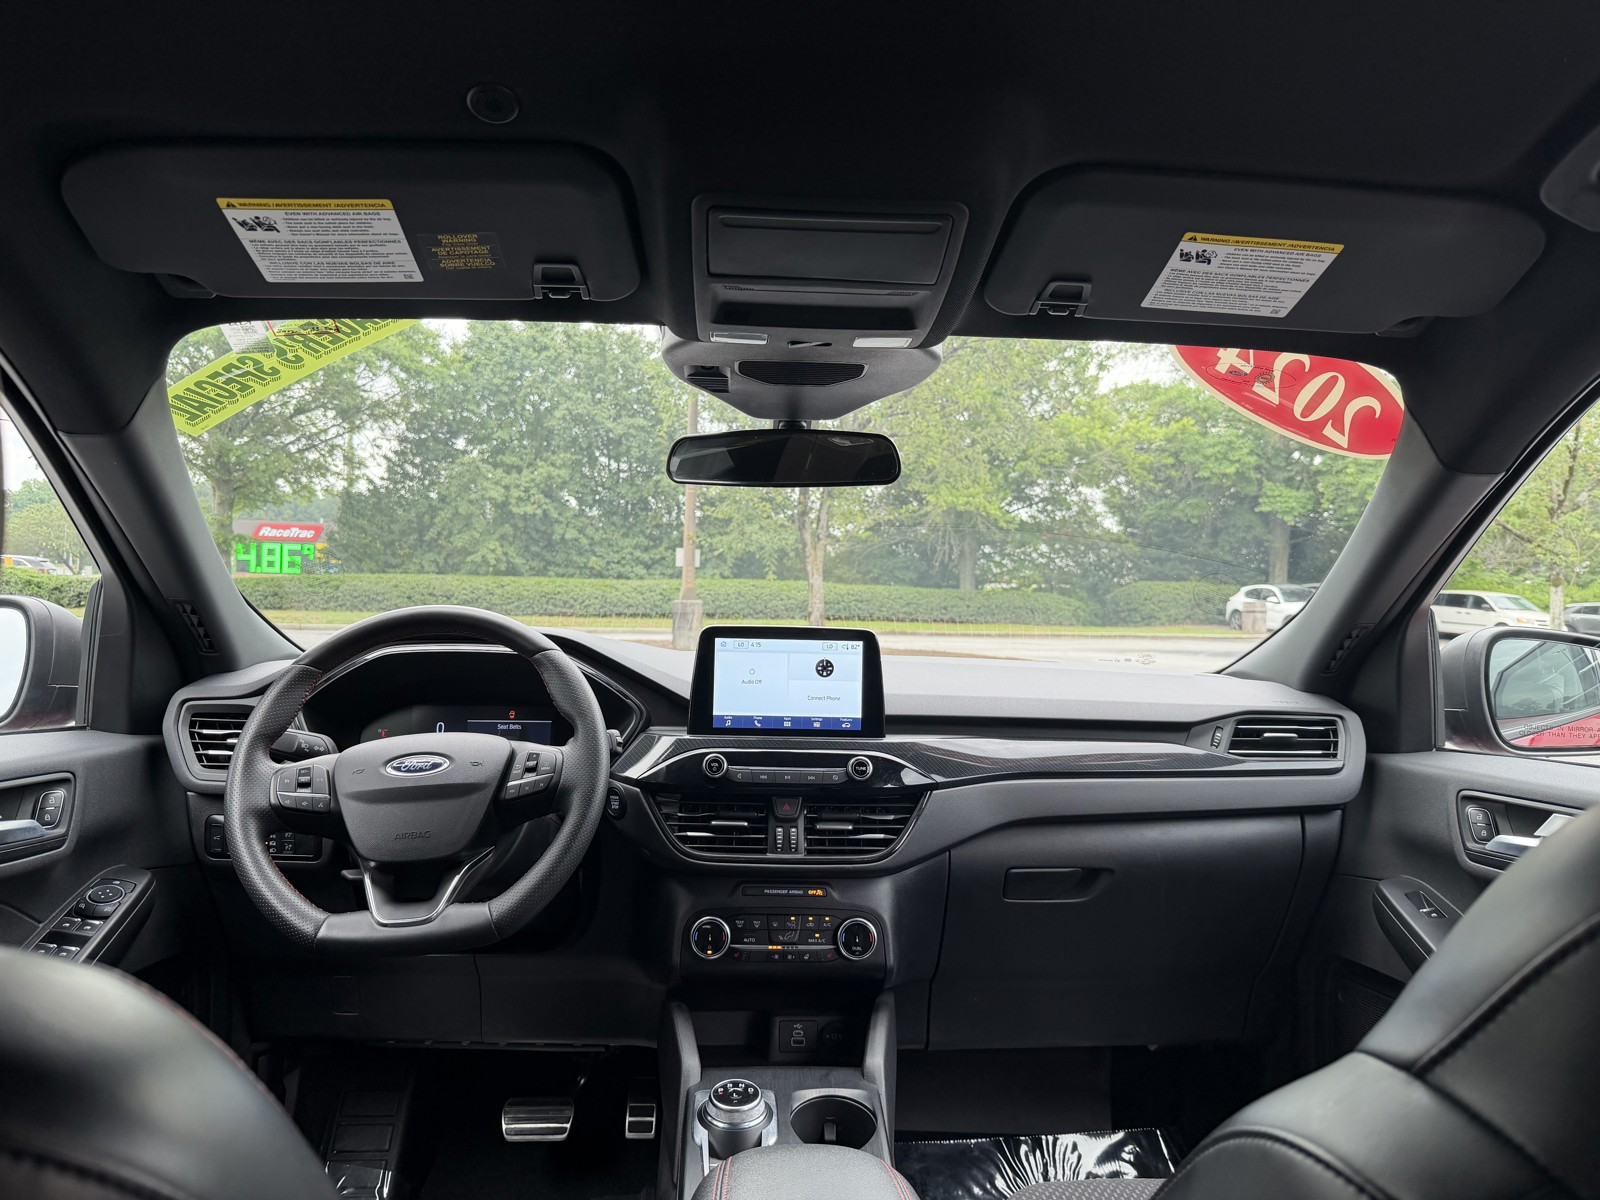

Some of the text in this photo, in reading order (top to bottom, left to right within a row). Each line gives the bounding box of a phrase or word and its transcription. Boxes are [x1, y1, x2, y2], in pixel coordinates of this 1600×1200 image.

[258, 526, 316, 539] RaceTrac
[436, 722, 445, 733] 0
[392, 760, 433, 771] Ford
[394, 830, 432, 841] AIRBAG
